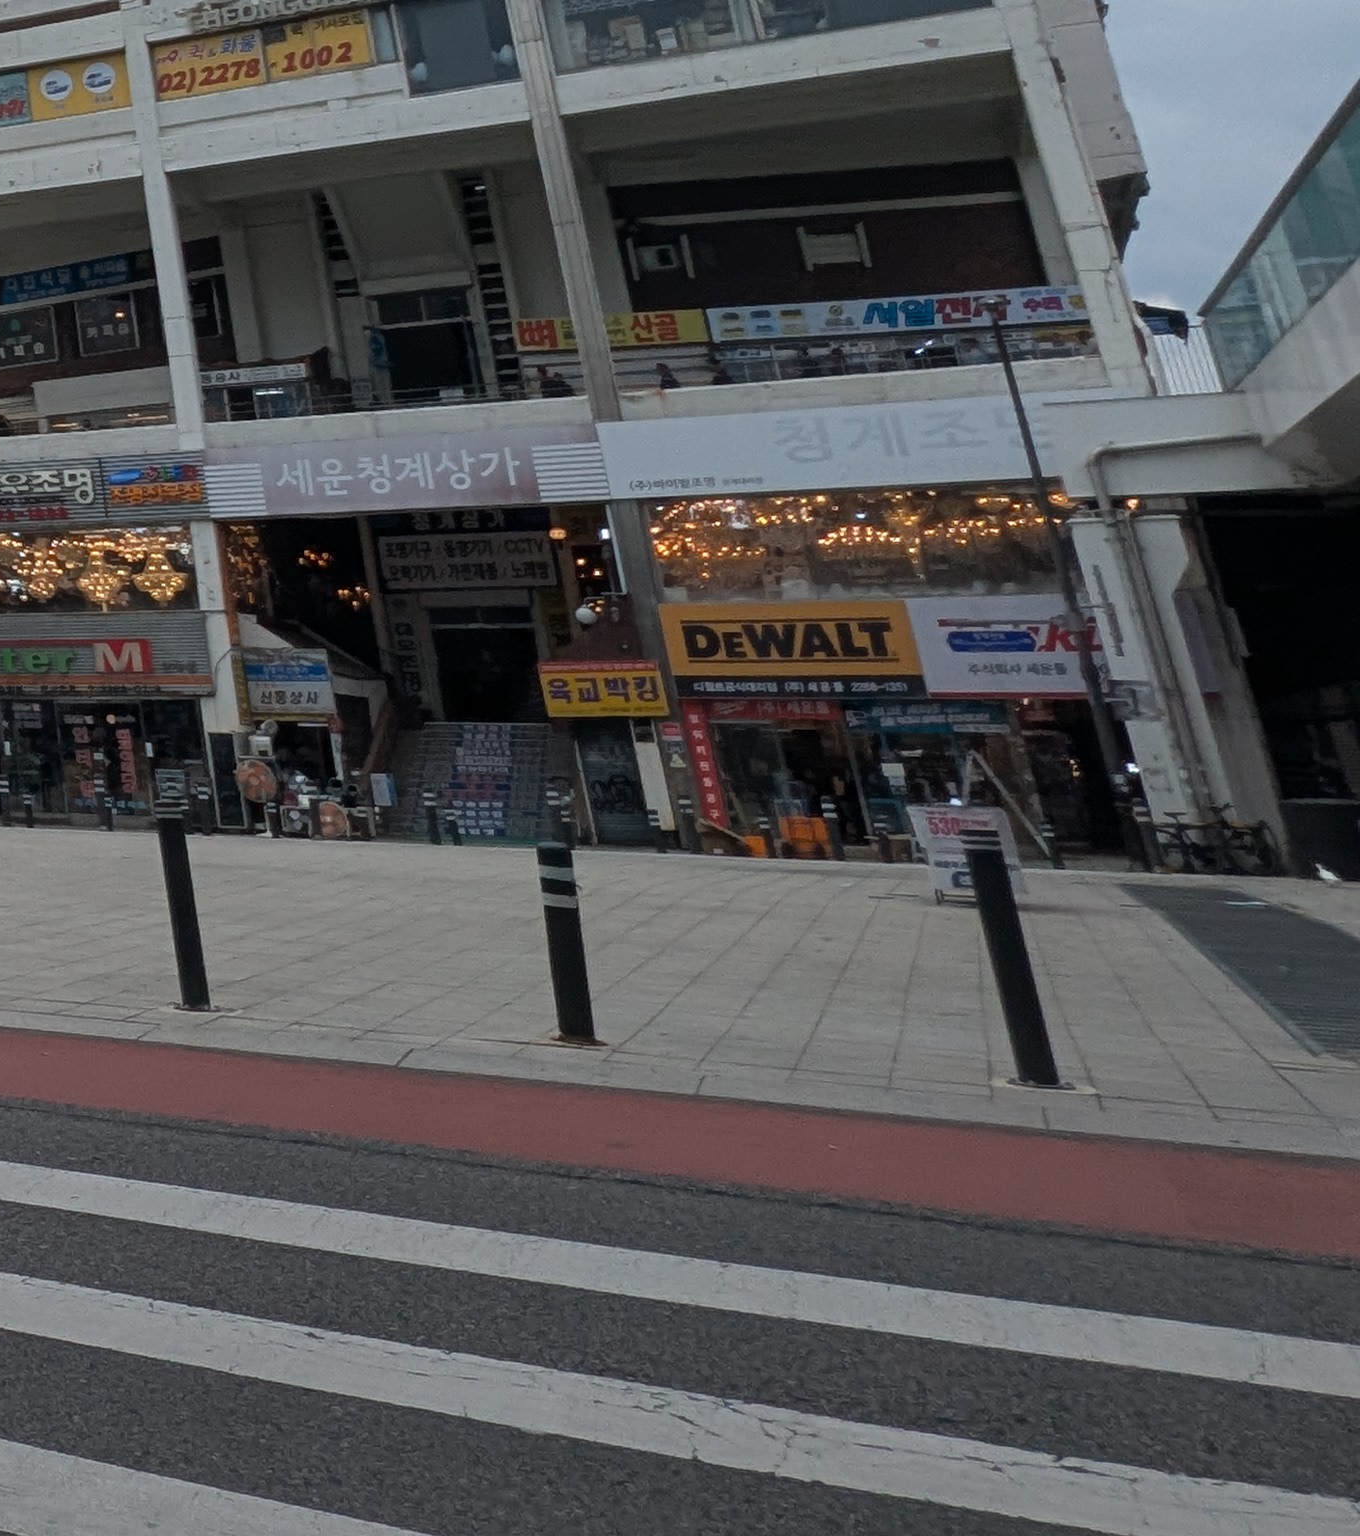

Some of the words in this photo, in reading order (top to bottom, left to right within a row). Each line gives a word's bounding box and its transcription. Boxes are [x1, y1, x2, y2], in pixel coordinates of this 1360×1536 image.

[281, 41, 353, 73] 1002
[276, 446, 521, 498] 세운청계상가
[504, 538, 544, 555] CCTV
